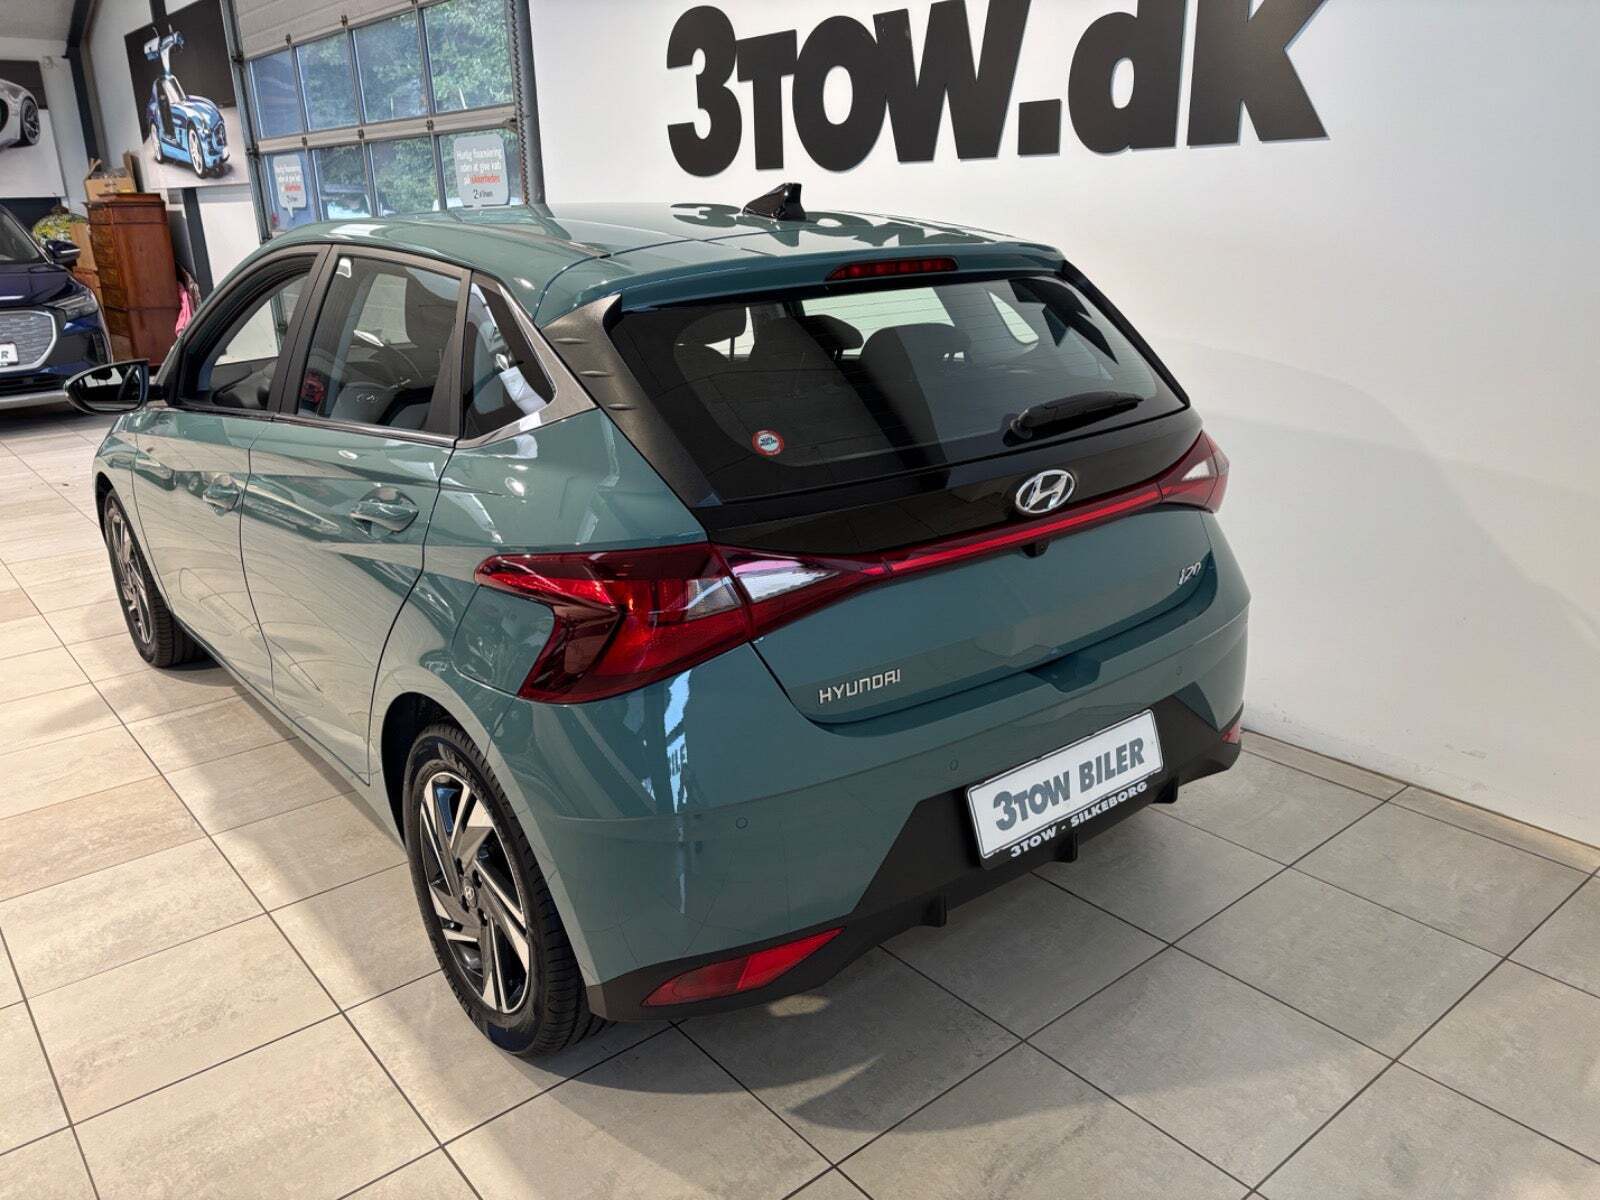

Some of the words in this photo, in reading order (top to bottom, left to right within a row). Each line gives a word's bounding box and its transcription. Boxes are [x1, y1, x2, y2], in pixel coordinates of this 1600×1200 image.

[818, 668, 901, 705] HYUNDAI
[992, 770, 1071, 832] 3TOW
[1078, 736, 1145, 793] BILER
[1009, 824, 1058, 858] 3TOW
[1070, 780, 1148, 828] SILKEBORG
